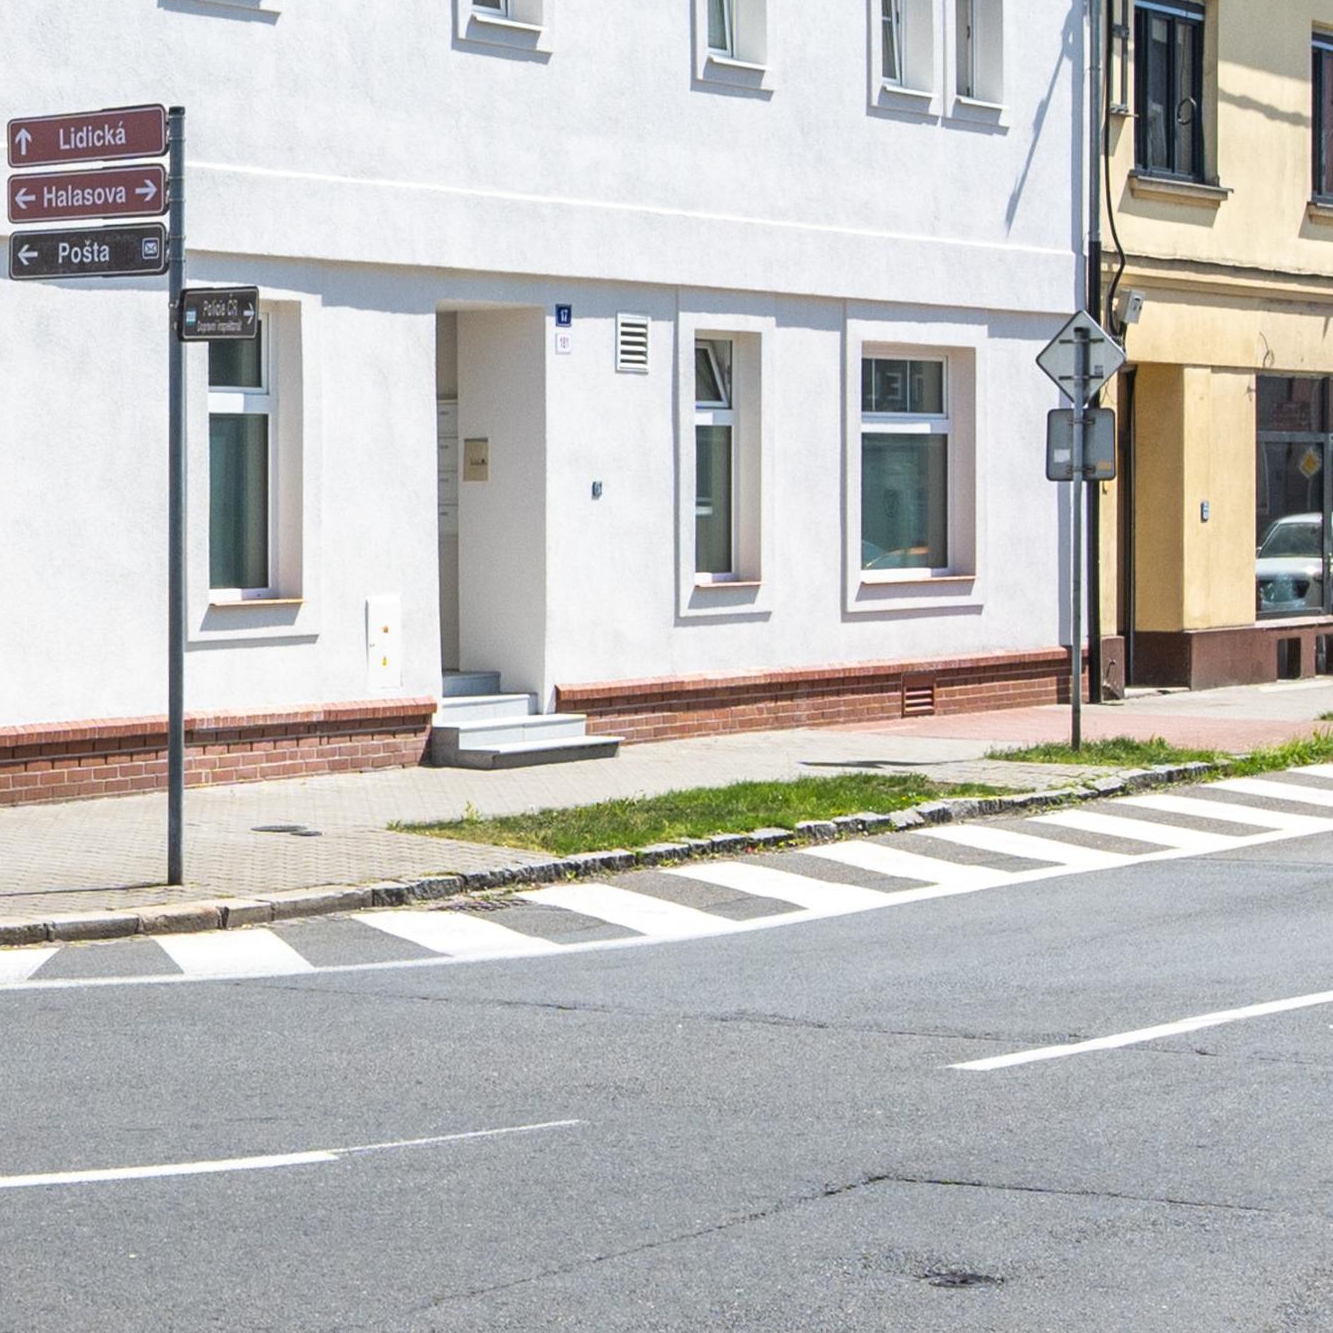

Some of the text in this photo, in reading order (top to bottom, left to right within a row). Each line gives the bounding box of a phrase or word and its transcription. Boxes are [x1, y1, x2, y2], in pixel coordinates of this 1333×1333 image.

[59, 120, 127, 149] Lidická
[43, 184, 126, 208] Halasova
[58, 239, 110, 264] Pošta
